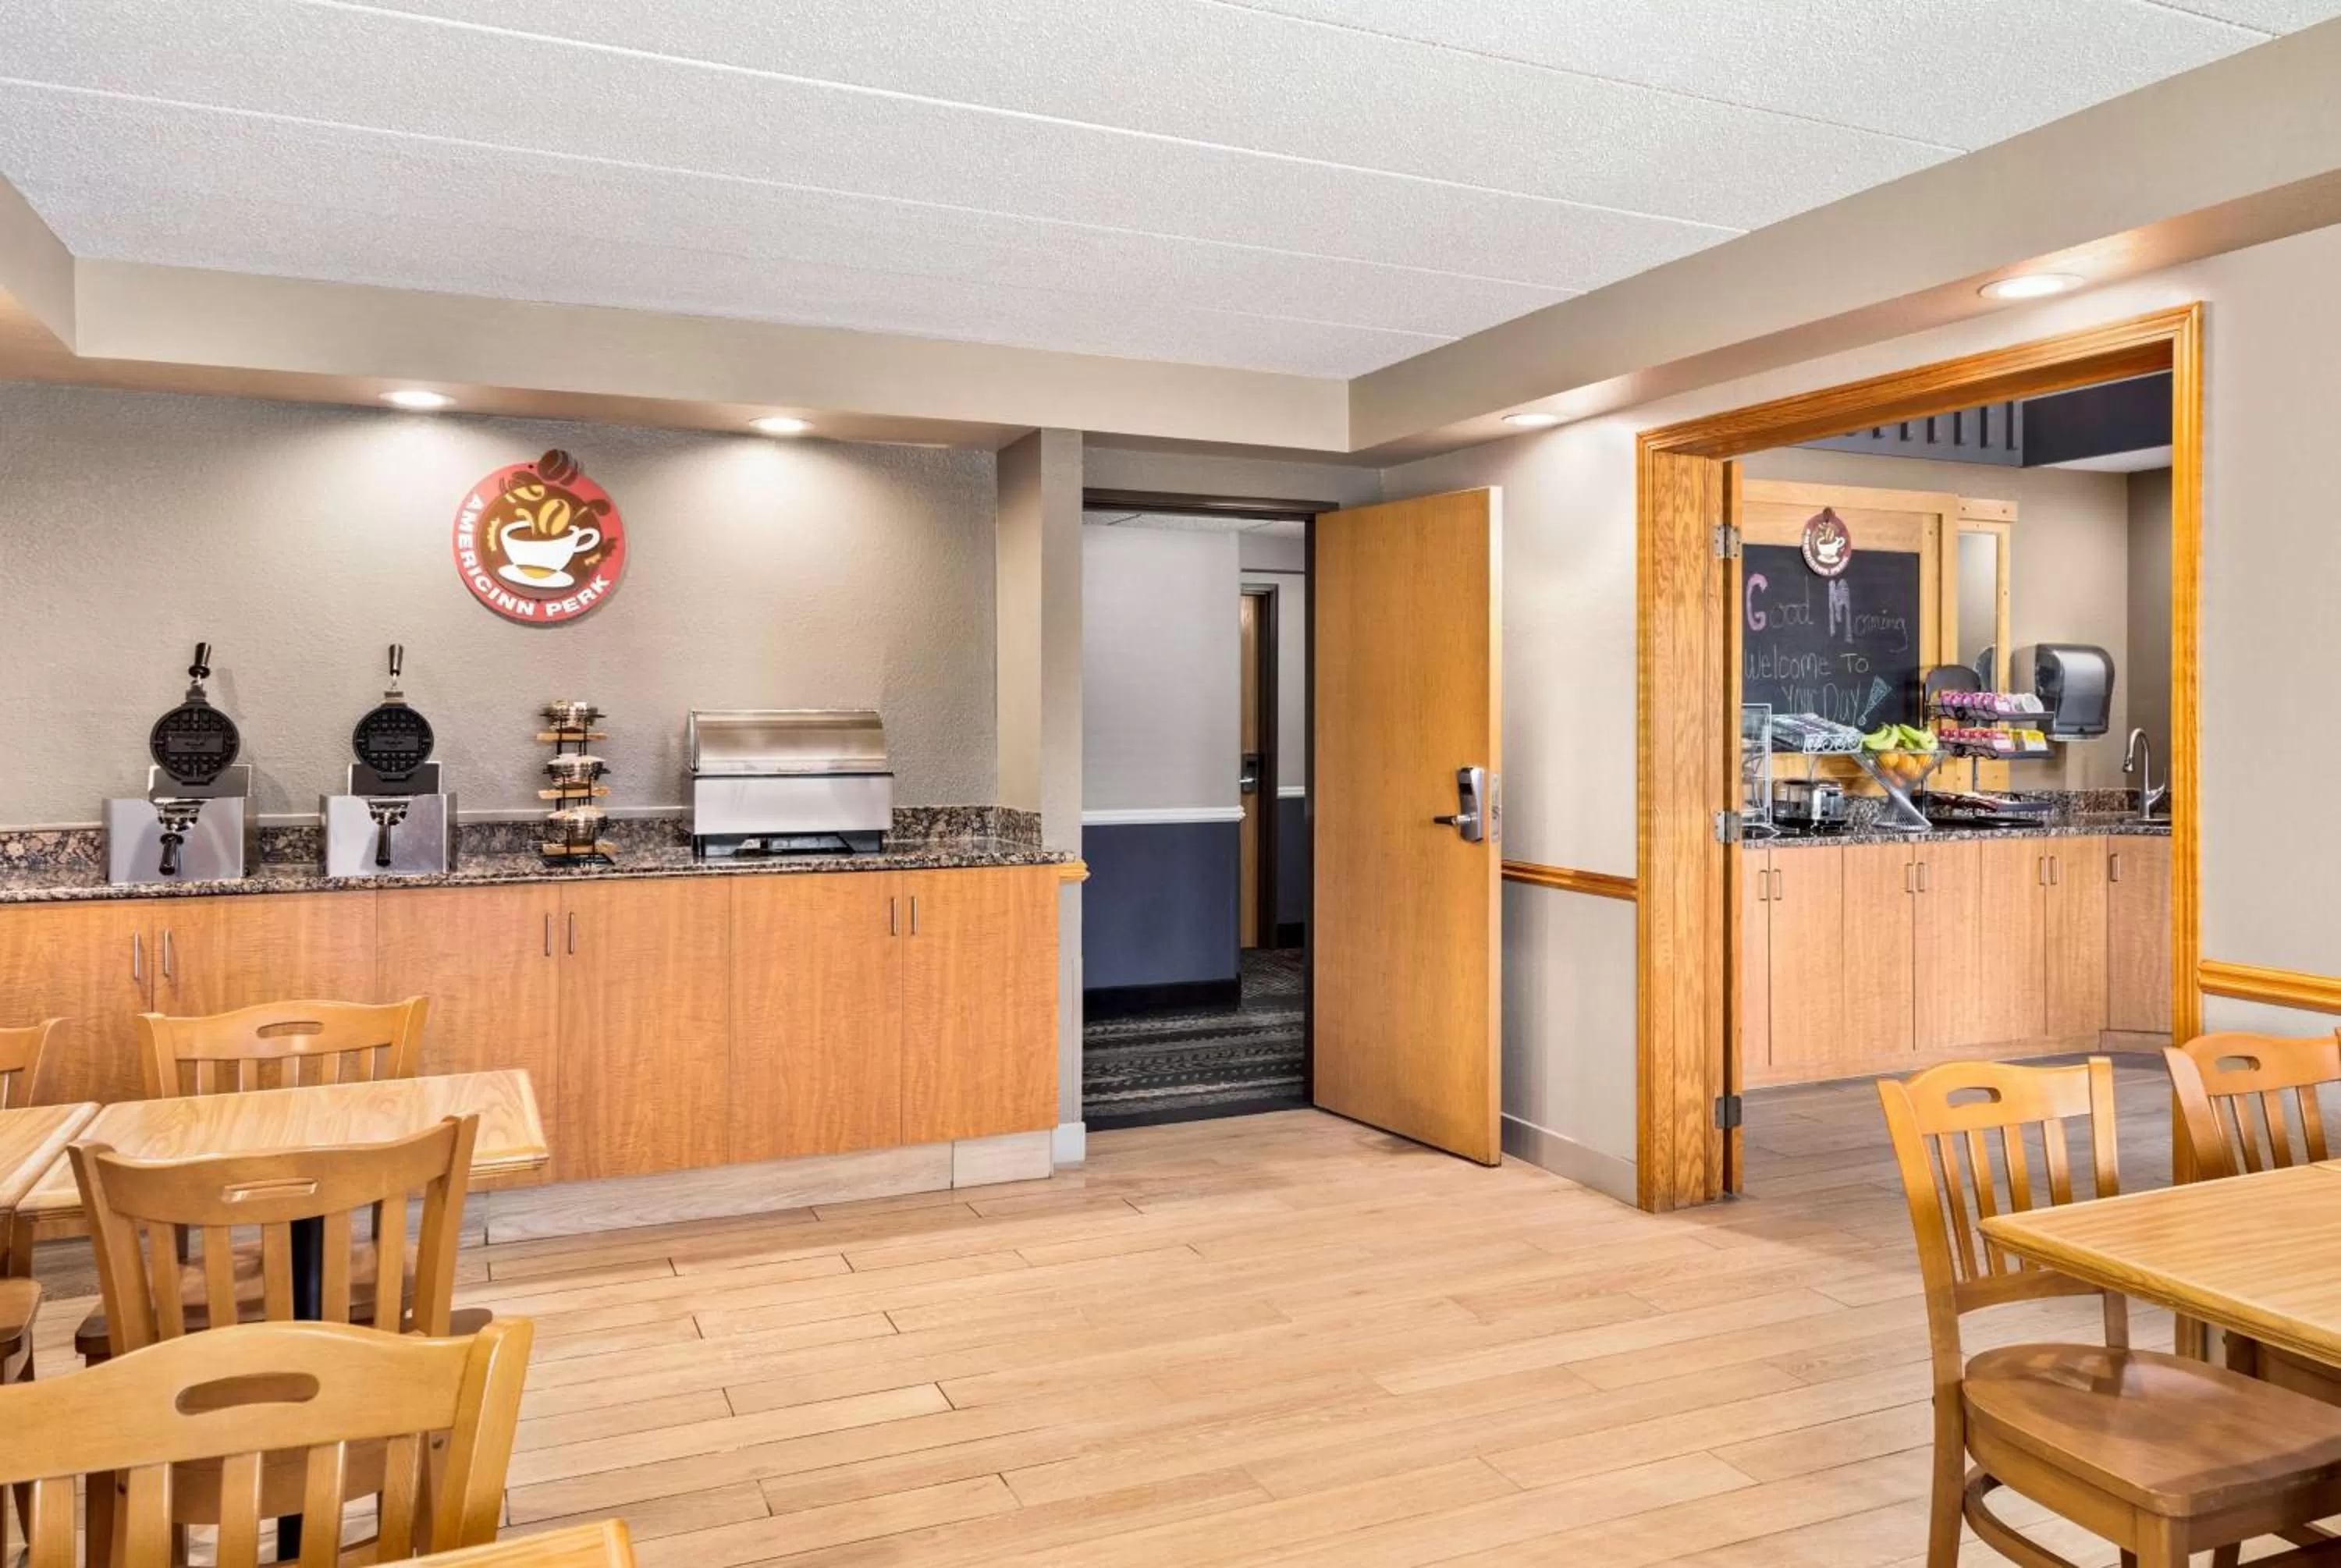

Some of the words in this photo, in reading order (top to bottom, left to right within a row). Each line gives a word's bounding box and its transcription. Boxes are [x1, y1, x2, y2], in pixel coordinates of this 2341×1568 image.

[458, 494, 536, 616] AMERICINN
[545, 574, 611, 617] PERK
[1746, 573, 1814, 631] Good
[1744, 644, 1832, 681] Welcome
[1839, 652, 1870, 673] To
